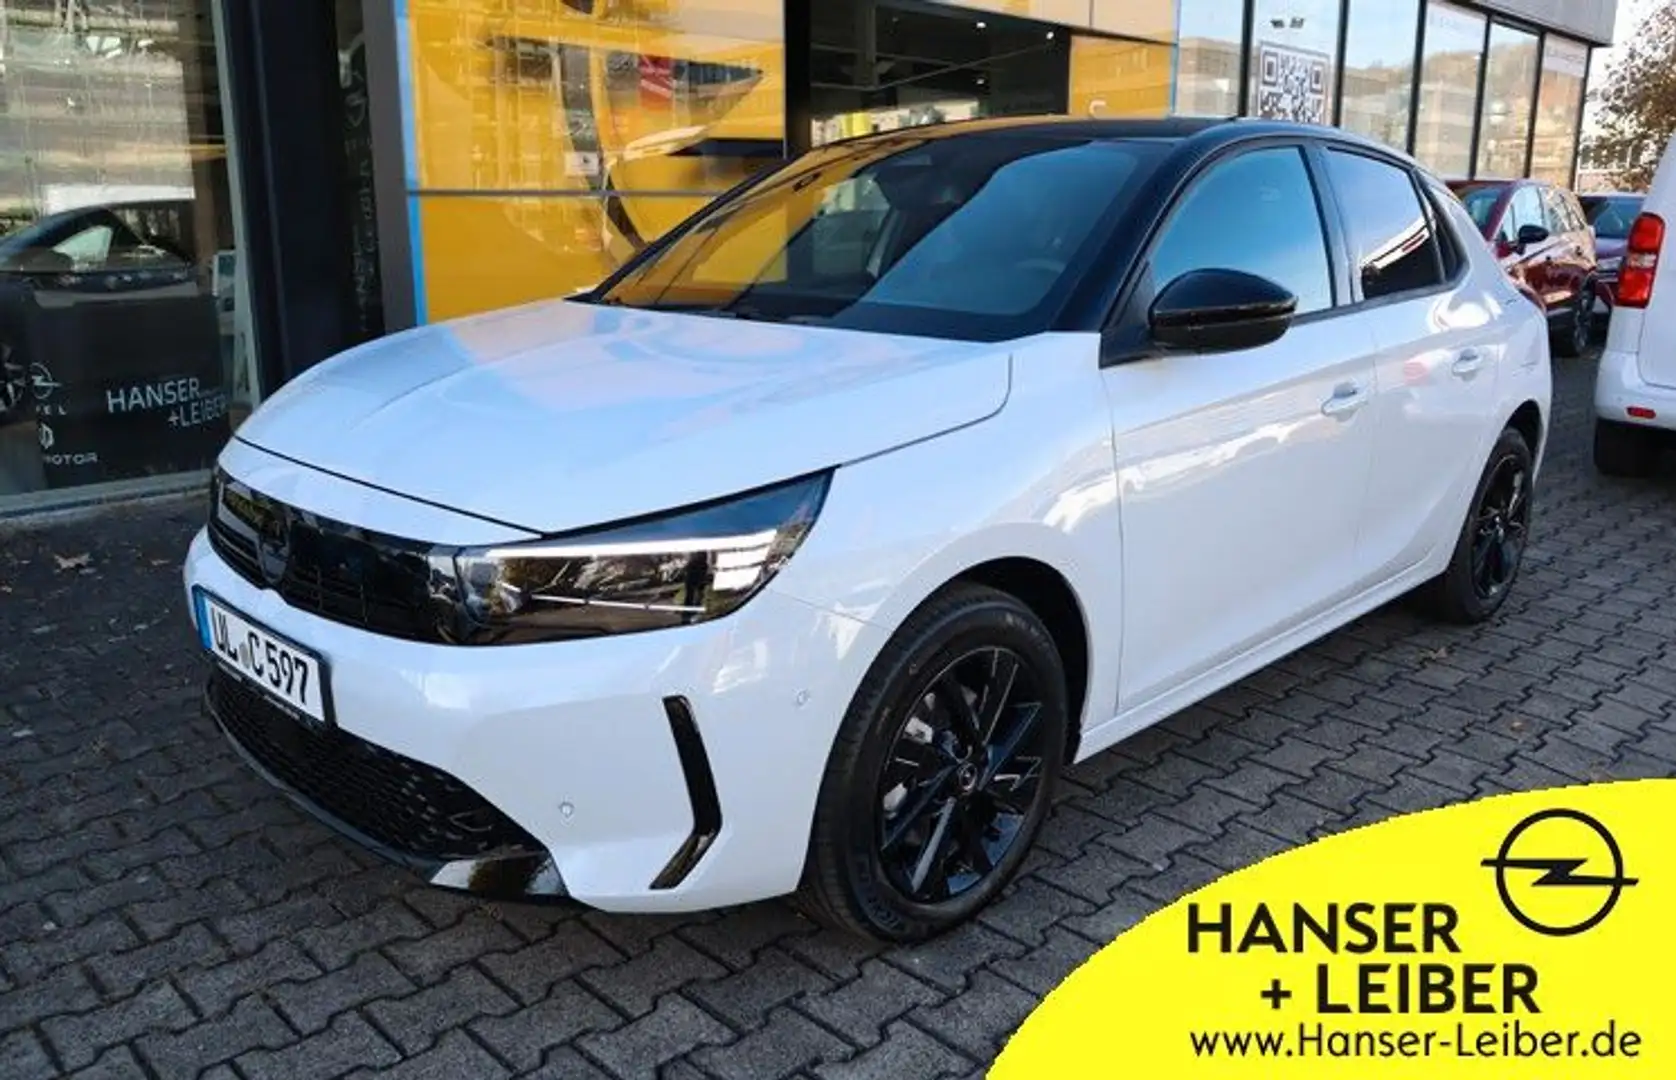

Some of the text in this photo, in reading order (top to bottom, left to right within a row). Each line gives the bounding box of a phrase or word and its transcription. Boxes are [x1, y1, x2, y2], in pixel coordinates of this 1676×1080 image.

[106, 378, 200, 413] HANSER
[211, 607, 238, 662] UL
[265, 639, 309, 706] 597
